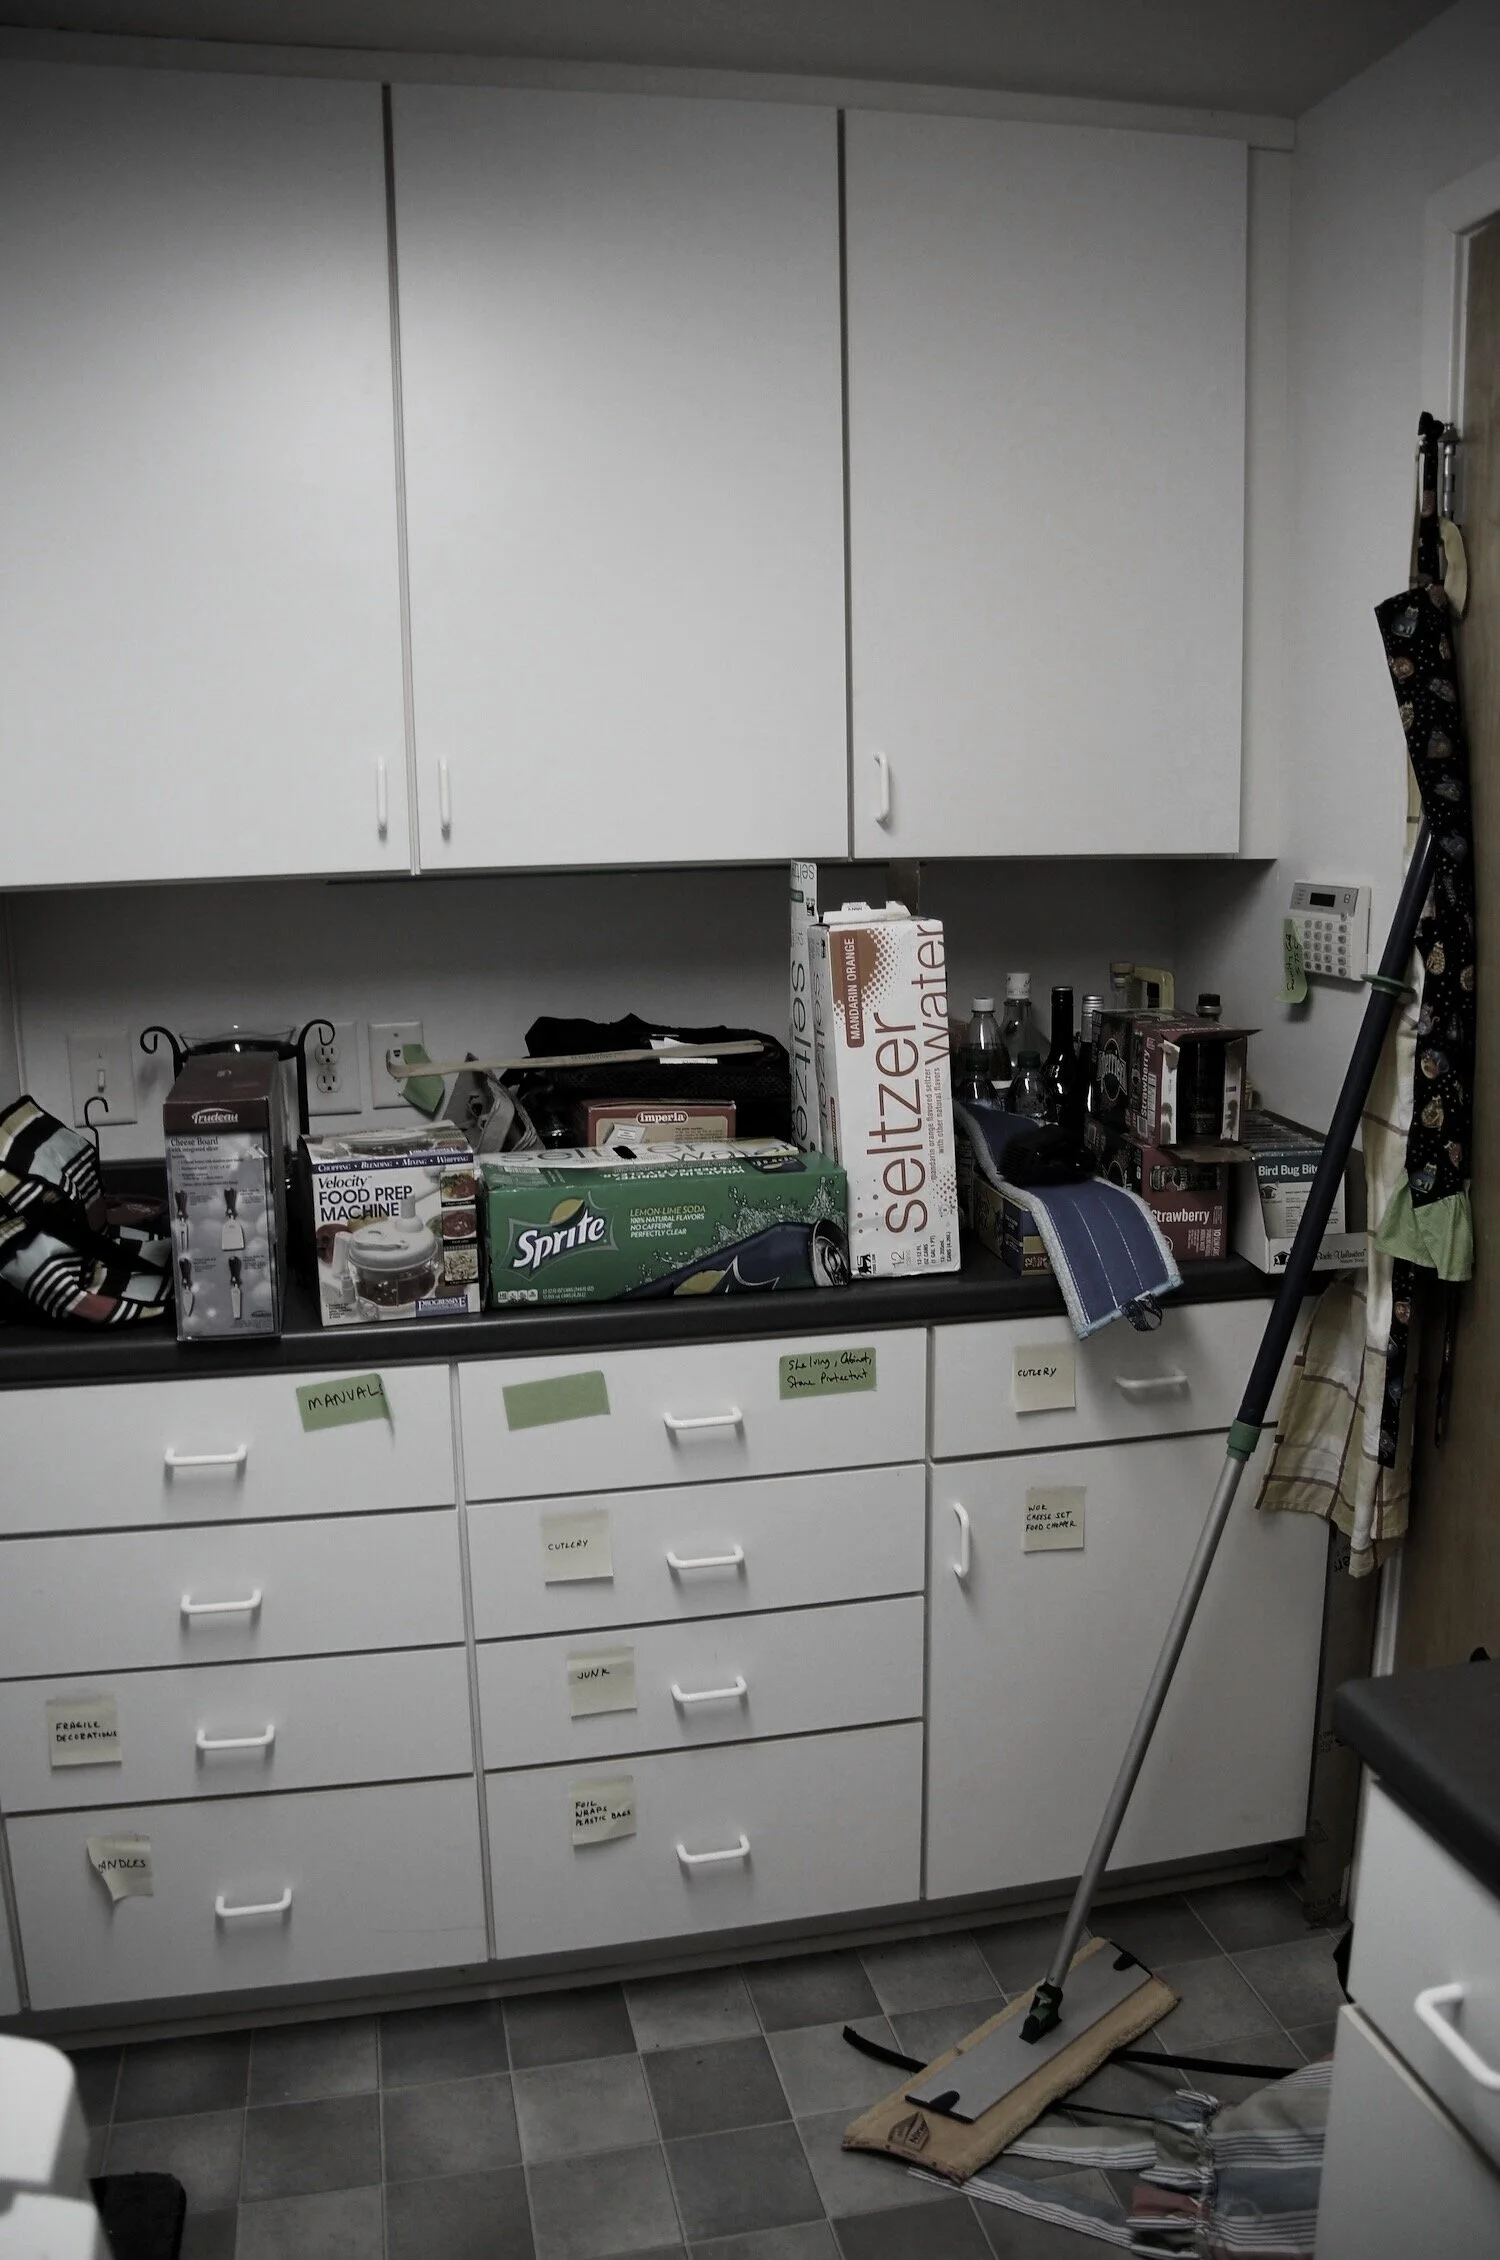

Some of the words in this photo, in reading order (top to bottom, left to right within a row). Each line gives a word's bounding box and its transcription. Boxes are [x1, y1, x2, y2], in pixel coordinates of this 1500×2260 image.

[844, 938, 857, 981] ORANGE
[847, 984, 860, 1040] MANDARIN
[924, 1068, 932, 1093] seltzer
[934, 1068, 942, 1090] flavors
[1141, 1049, 1151, 1120] Strawberry
[926, 1095, 934, 1122] flavored
[935, 1093, 943, 1118] natural
[191, 1107, 239, 1124] Trudeau
[638, 1112, 686, 1124] imperia
[867, 1012, 928, 1233] seltzer
[927, 1123, 936, 1146] orange
[936, 1119, 944, 1138] other
[170, 1137, 196, 1147] Cheese
[197, 1136, 219, 1146] Board
[1258, 1165, 1278, 1176] Bird
[1280, 1164, 1300, 1177] Bug
[318, 1174, 368, 1190] Velocity
[319, 1189, 370, 1206] FOOD
[375, 1186, 412, 1201] PREP
[320, 1202, 400, 1222] MACHINE
[682, 1205, 706, 1214] SODA
[1152, 1208, 1210, 1225] Strawberry
[642, 1222, 673, 1230] CAFFEINE
[646, 1215, 675, 1223] NATURAL
[675, 1213, 705, 1221] FLAVORS
[512, 1208, 606, 1269] Sprite
[630, 1229, 666, 1238] PERFECTLY
[666, 1228, 687, 1236] CLEAR
[890, 1251, 905, 1268] 12
[1017, 1367, 1057, 1377] CUTLERY
[1055, 1510, 1073, 1519] SET
[1025, 1523, 1043, 1532] FOOD
[547, 1539, 588, 1551] CUTLERY
[577, 1667, 610, 1680] JUNK
[55, 1721, 100, 1731] FRAGILE
[56, 1730, 117, 1742] DECORATIONS
[575, 1801, 597, 1809] FOIL
[575, 1815, 606, 1827] PLASTIC
